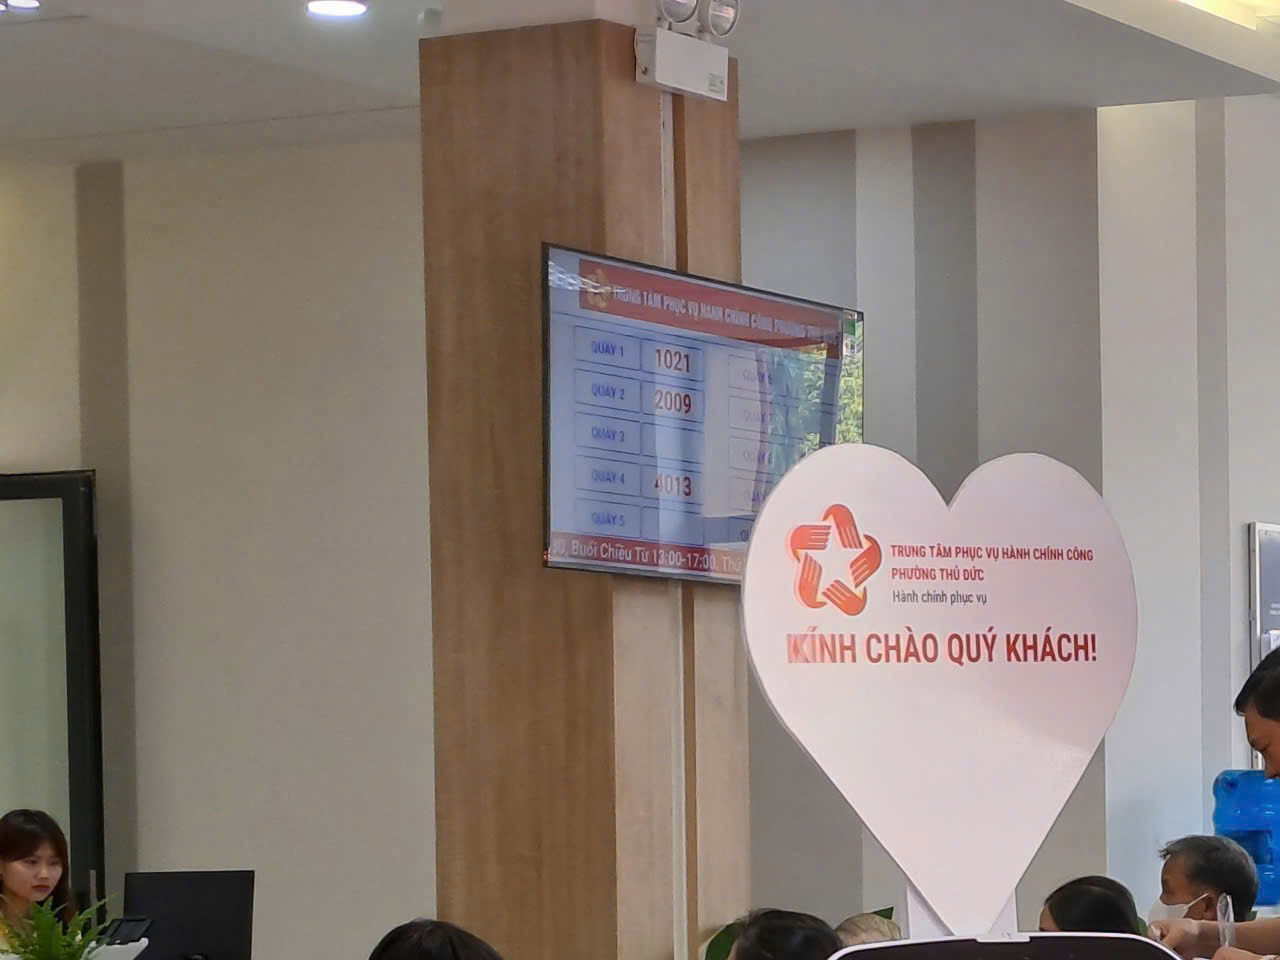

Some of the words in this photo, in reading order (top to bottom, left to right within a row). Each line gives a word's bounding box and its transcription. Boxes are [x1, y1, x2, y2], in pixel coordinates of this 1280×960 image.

[656, 348, 690, 373] 1021
[619, 388, 625, 400] 2
[655, 389, 692, 414] 2009
[654, 473, 692, 496] 4013
[890, 545, 926, 558] TRUNG
[929, 543, 952, 558] TÂM
[955, 546, 983, 562] PHỤC
[985, 546, 999, 562] VỤ
[1002, 545, 1030, 560] HÀNH
[1033, 545, 1063, 560] CHÍNH
[1066, 546, 1093, 561] CÔNG
[891, 565, 936, 580] PHƯỜNG
[939, 565, 960, 581] THỦ
[963, 565, 984, 581] ĐỨC
[893, 590, 918, 603] Hành
[921, 590, 947, 603] chính
[950, 591, 973, 606] phục
[976, 593, 987, 606] vụ
[786, 625, 856, 664] KÍNH
[865, 625, 939, 664] CHÀO
[947, 625, 997, 666] QUÝ
[1006, 625, 1097, 663] KHÁCH!
